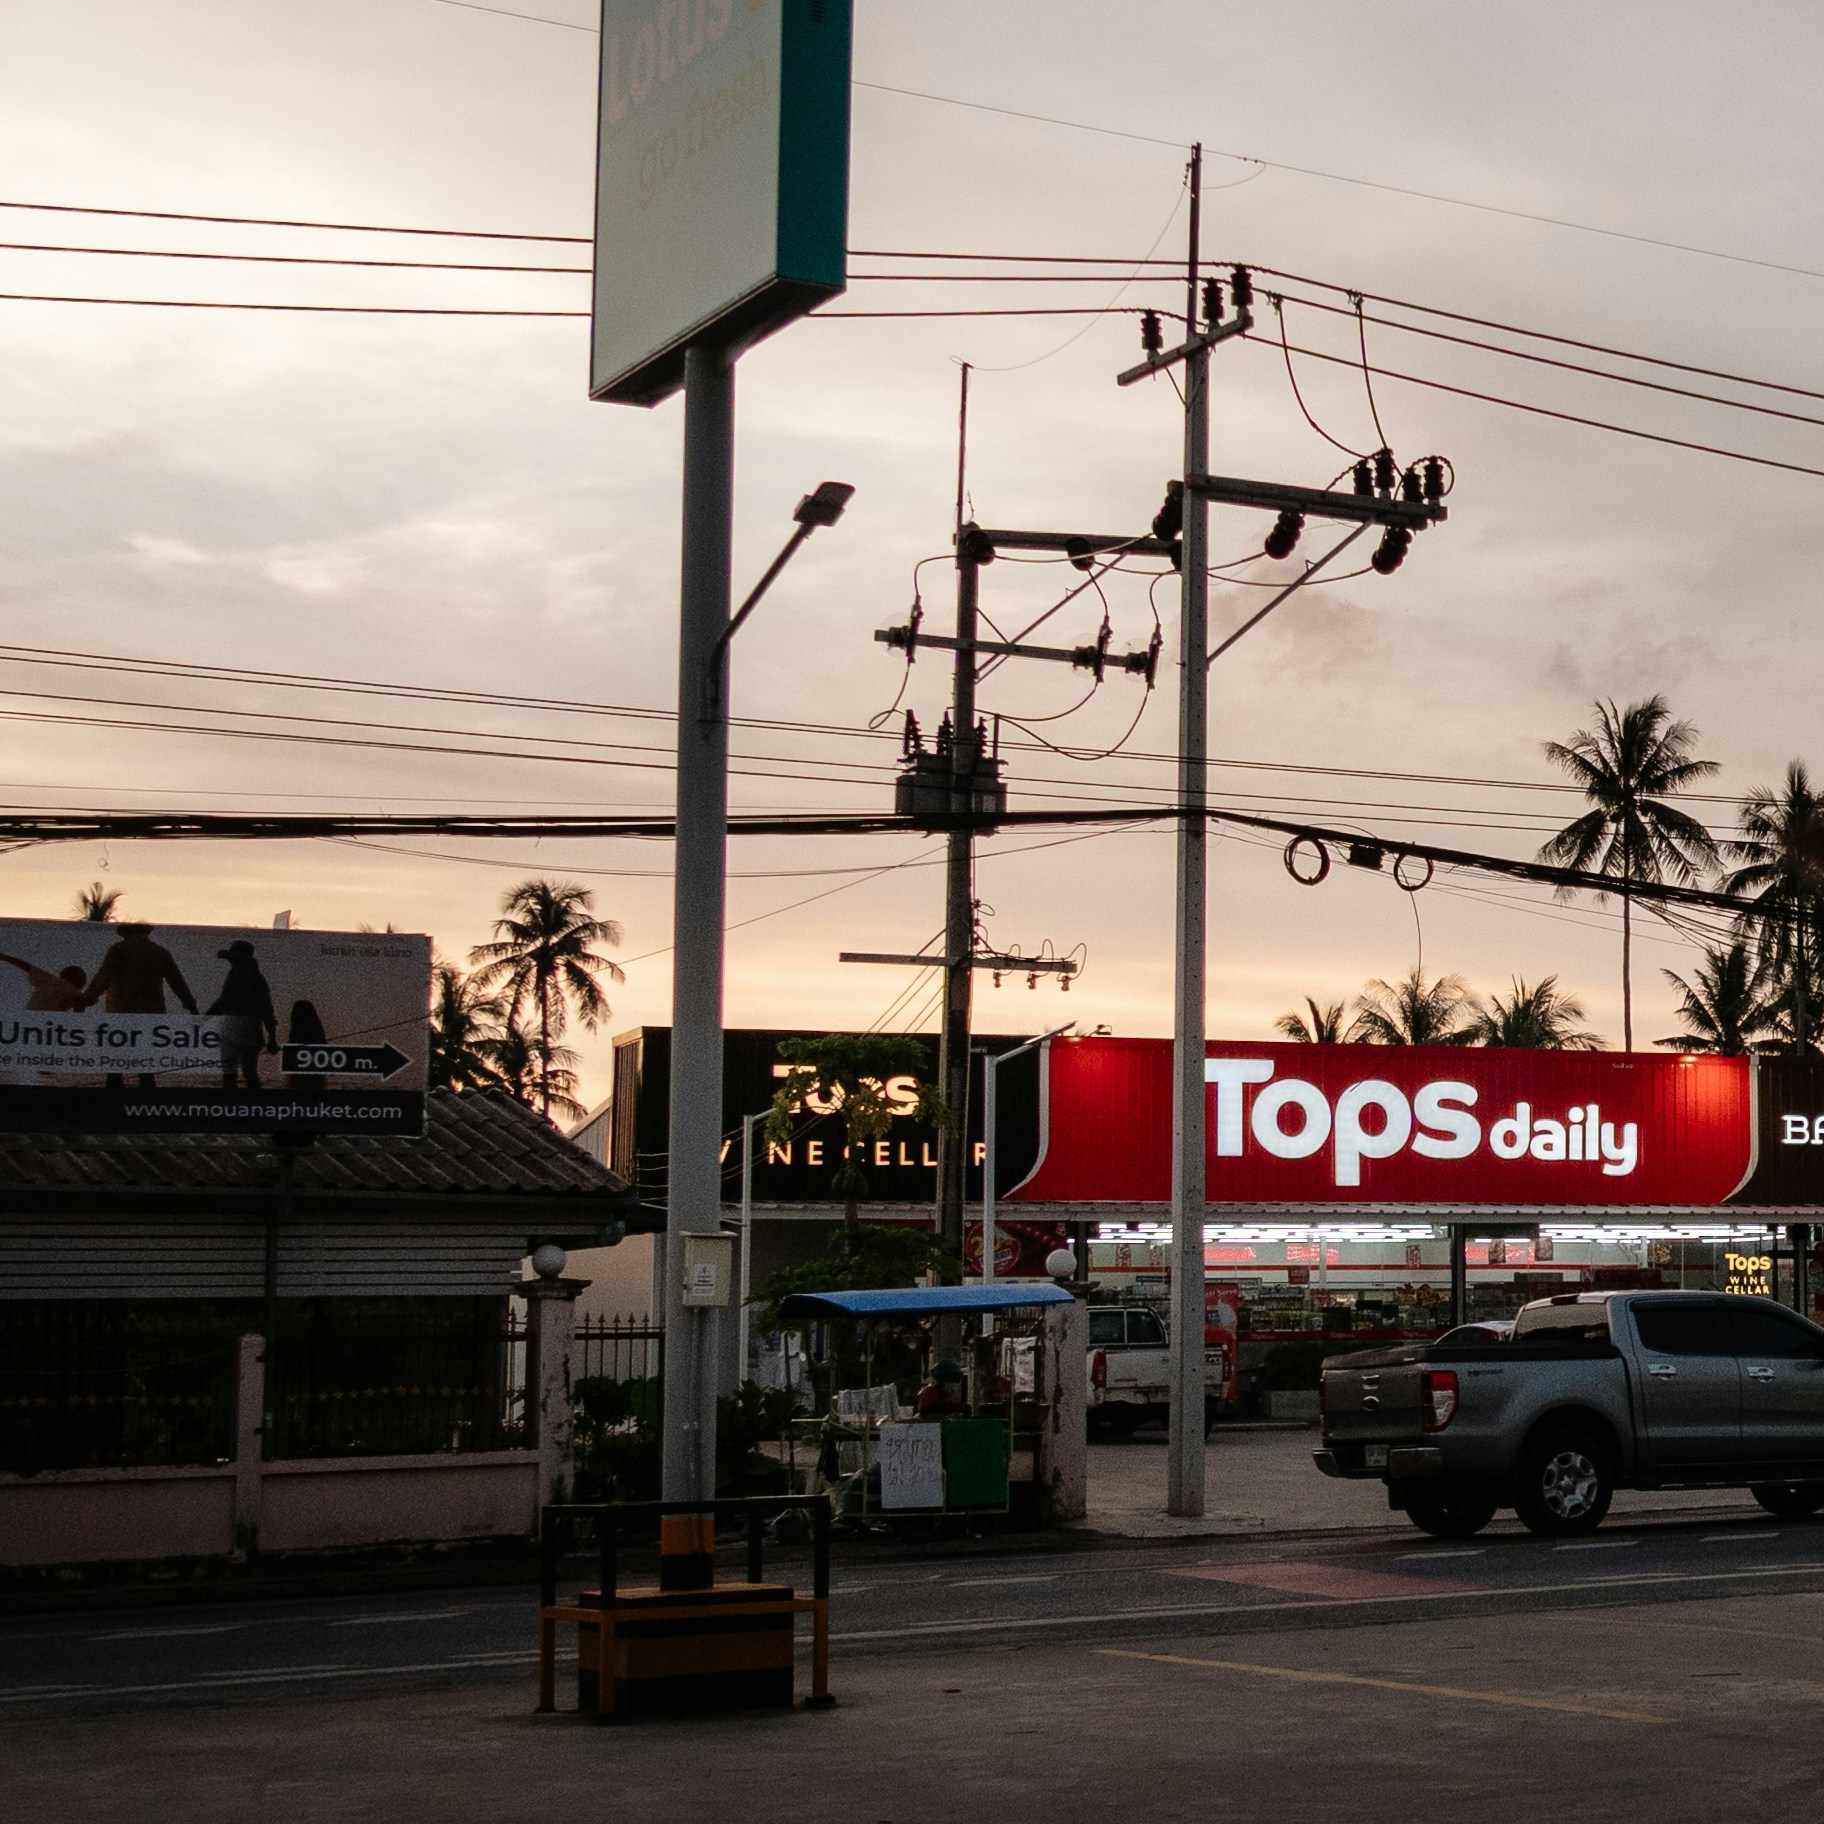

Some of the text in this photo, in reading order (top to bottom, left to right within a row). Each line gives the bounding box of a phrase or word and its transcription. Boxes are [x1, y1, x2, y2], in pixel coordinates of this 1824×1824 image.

[0, 1021, 220, 1049] Units for Sale
[17, 1052, 65, 1066] inside
[69, 1054, 96, 1067] the
[100, 1055, 155, 1071] Project
[296, 1049, 378, 1071] 900 m.
[124, 1102, 402, 1121] www.mouanaphuket.com
[1205, 1057, 1638, 1187] Tops daily
[1724, 1253, 1772, 1275] Tops
[1725, 1285, 1770, 1295] CELLAR
[1729, 1276, 1766, 1285] WINE
